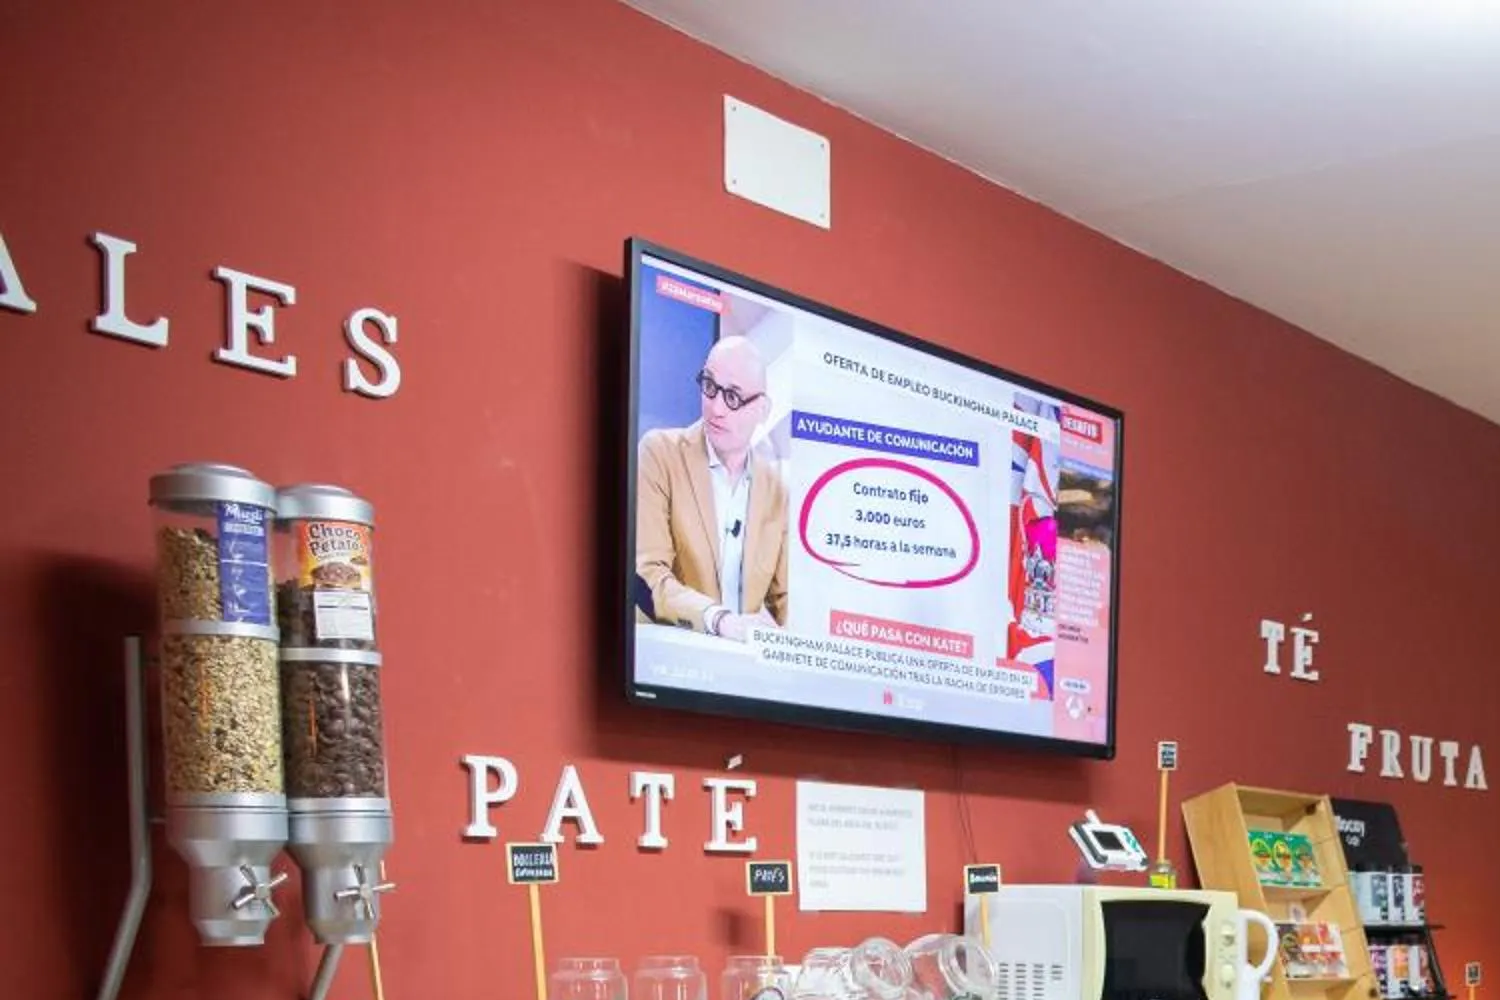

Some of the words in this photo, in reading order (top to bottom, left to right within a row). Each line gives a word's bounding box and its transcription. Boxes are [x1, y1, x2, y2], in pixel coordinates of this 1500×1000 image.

[823, 352, 869, 377] OFERTA
[871, 367, 885, 383] DE
[888, 373, 931, 396] EMPLEO
[932, 387, 1001, 420] BUCKINGHAM
[1002, 411, 1039, 432] PALACE
[797, 418, 864, 441] AYUDANTE
[867, 430, 883, 444] DE
[885, 432, 973, 458] COMUNICACIÓN
[853, 482, 907, 501] Contrato
[909, 489, 929, 505] fijo
[855, 509, 891, 524] 3.000
[893, 516, 926, 529] euros
[826, 533, 851, 550] 37,5
[853, 536, 888, 551] horas
[890, 541, 897, 553] a
[900, 540, 911, 553] la
[913, 544, 957, 559] semana
[753, 629, 823, 650] BUCKINGHAM
[825, 640, 863, 657] PALACE
[836, 619, 870, 636] ¿QUÉ
[871, 625, 903, 642] PASA
[905, 631, 931, 647] CON
[932, 634, 969, 654] KATE?
[1260, 613, 1320, 682] TÉ
[762, 648, 813, 667] GABINETE
[815, 657, 829, 669] DE
[1347, 722, 1489, 790] FRUTA
[461, 753, 757, 852] PATÉ
